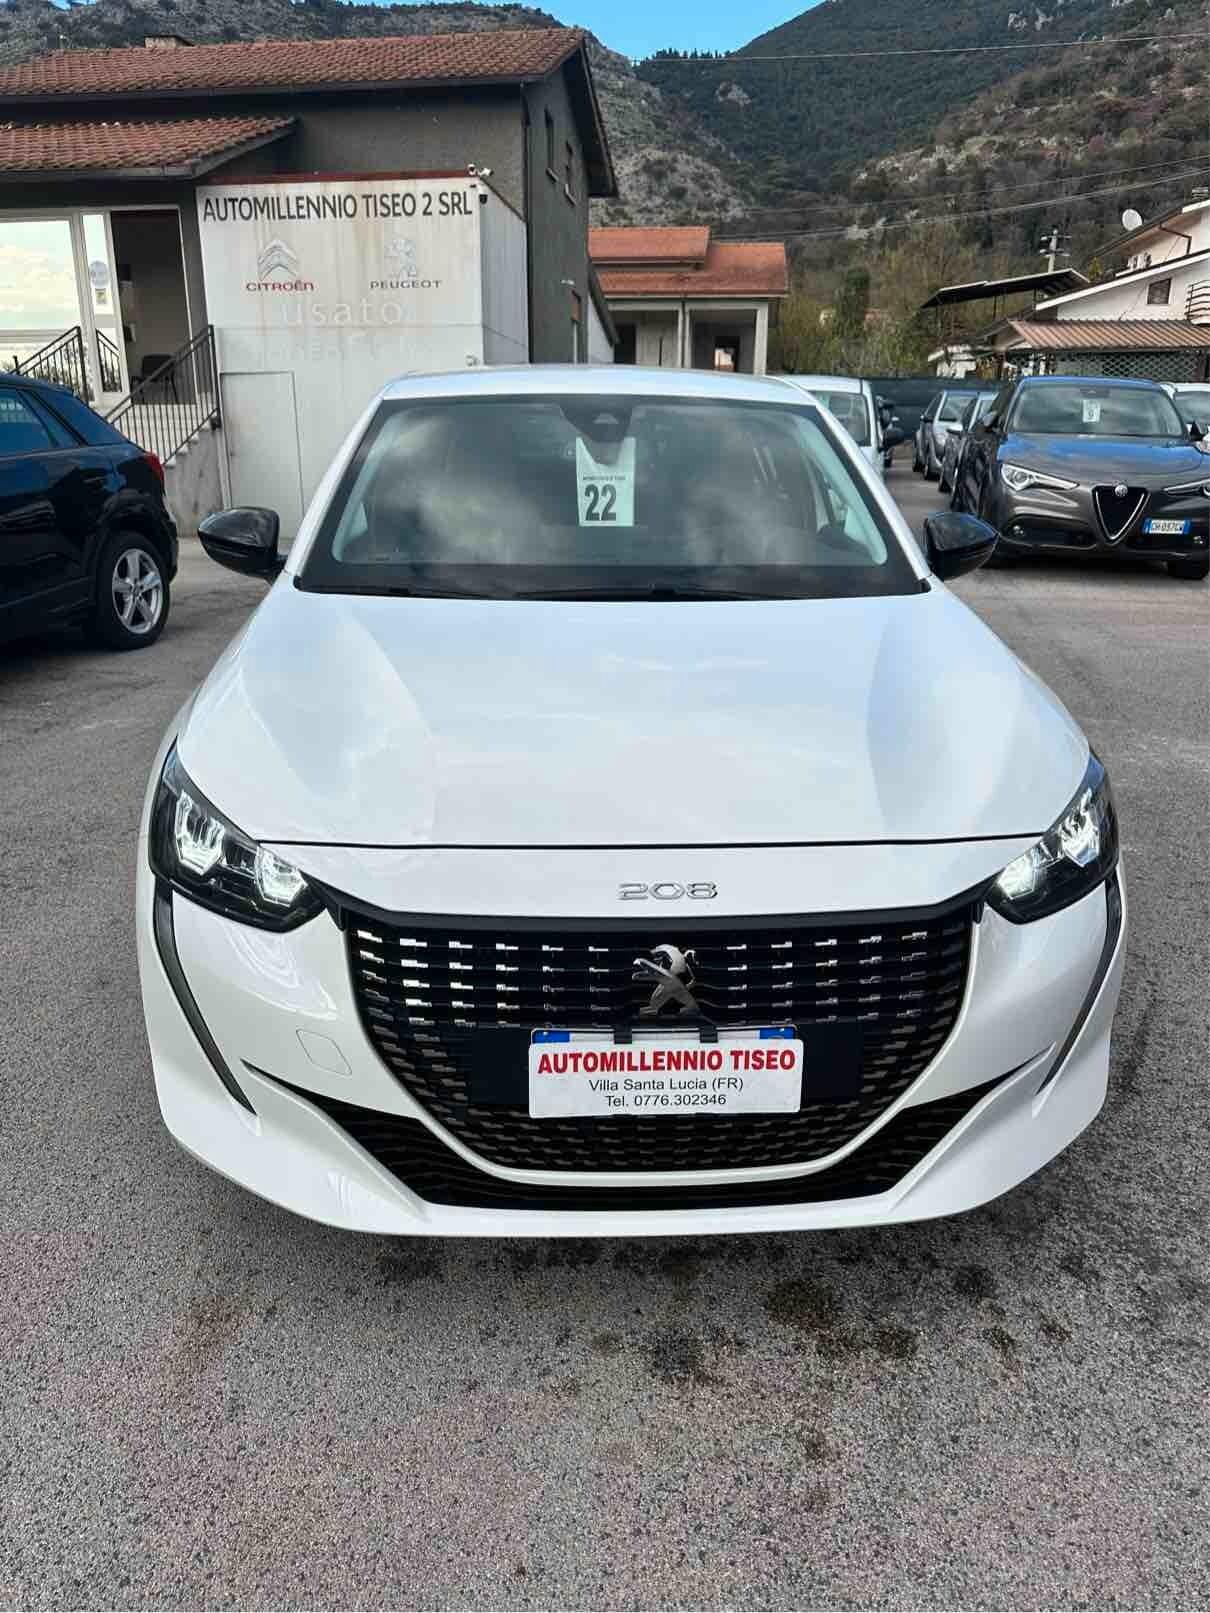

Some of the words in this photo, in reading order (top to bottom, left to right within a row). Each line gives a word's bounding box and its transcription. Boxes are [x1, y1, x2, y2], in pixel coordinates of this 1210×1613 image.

[203, 194, 357, 222] AUTOMILLENNIO
[361, 193, 416, 218] TISEO
[422, 192, 433, 216] 2
[438, 191, 473, 216] SRL
[370, 280, 443, 289] PEUGEOT
[281, 299, 403, 326] usato
[584, 484, 616, 521] 22
[618, 882, 718, 900] 208
[538, 1050, 723, 1074] AUTOMILLENNIO
[729, 1049, 796, 1071] TISEO
[588, 1079, 618, 1091] Villa
[623, 1078, 664, 1090] Santa
[669, 1078, 707, 1090] Lucia
[712, 1077, 744, 1092] (FR)
[605, 1095, 629, 1108] Tel.
[634, 1094, 727, 1107] 0776.302346
